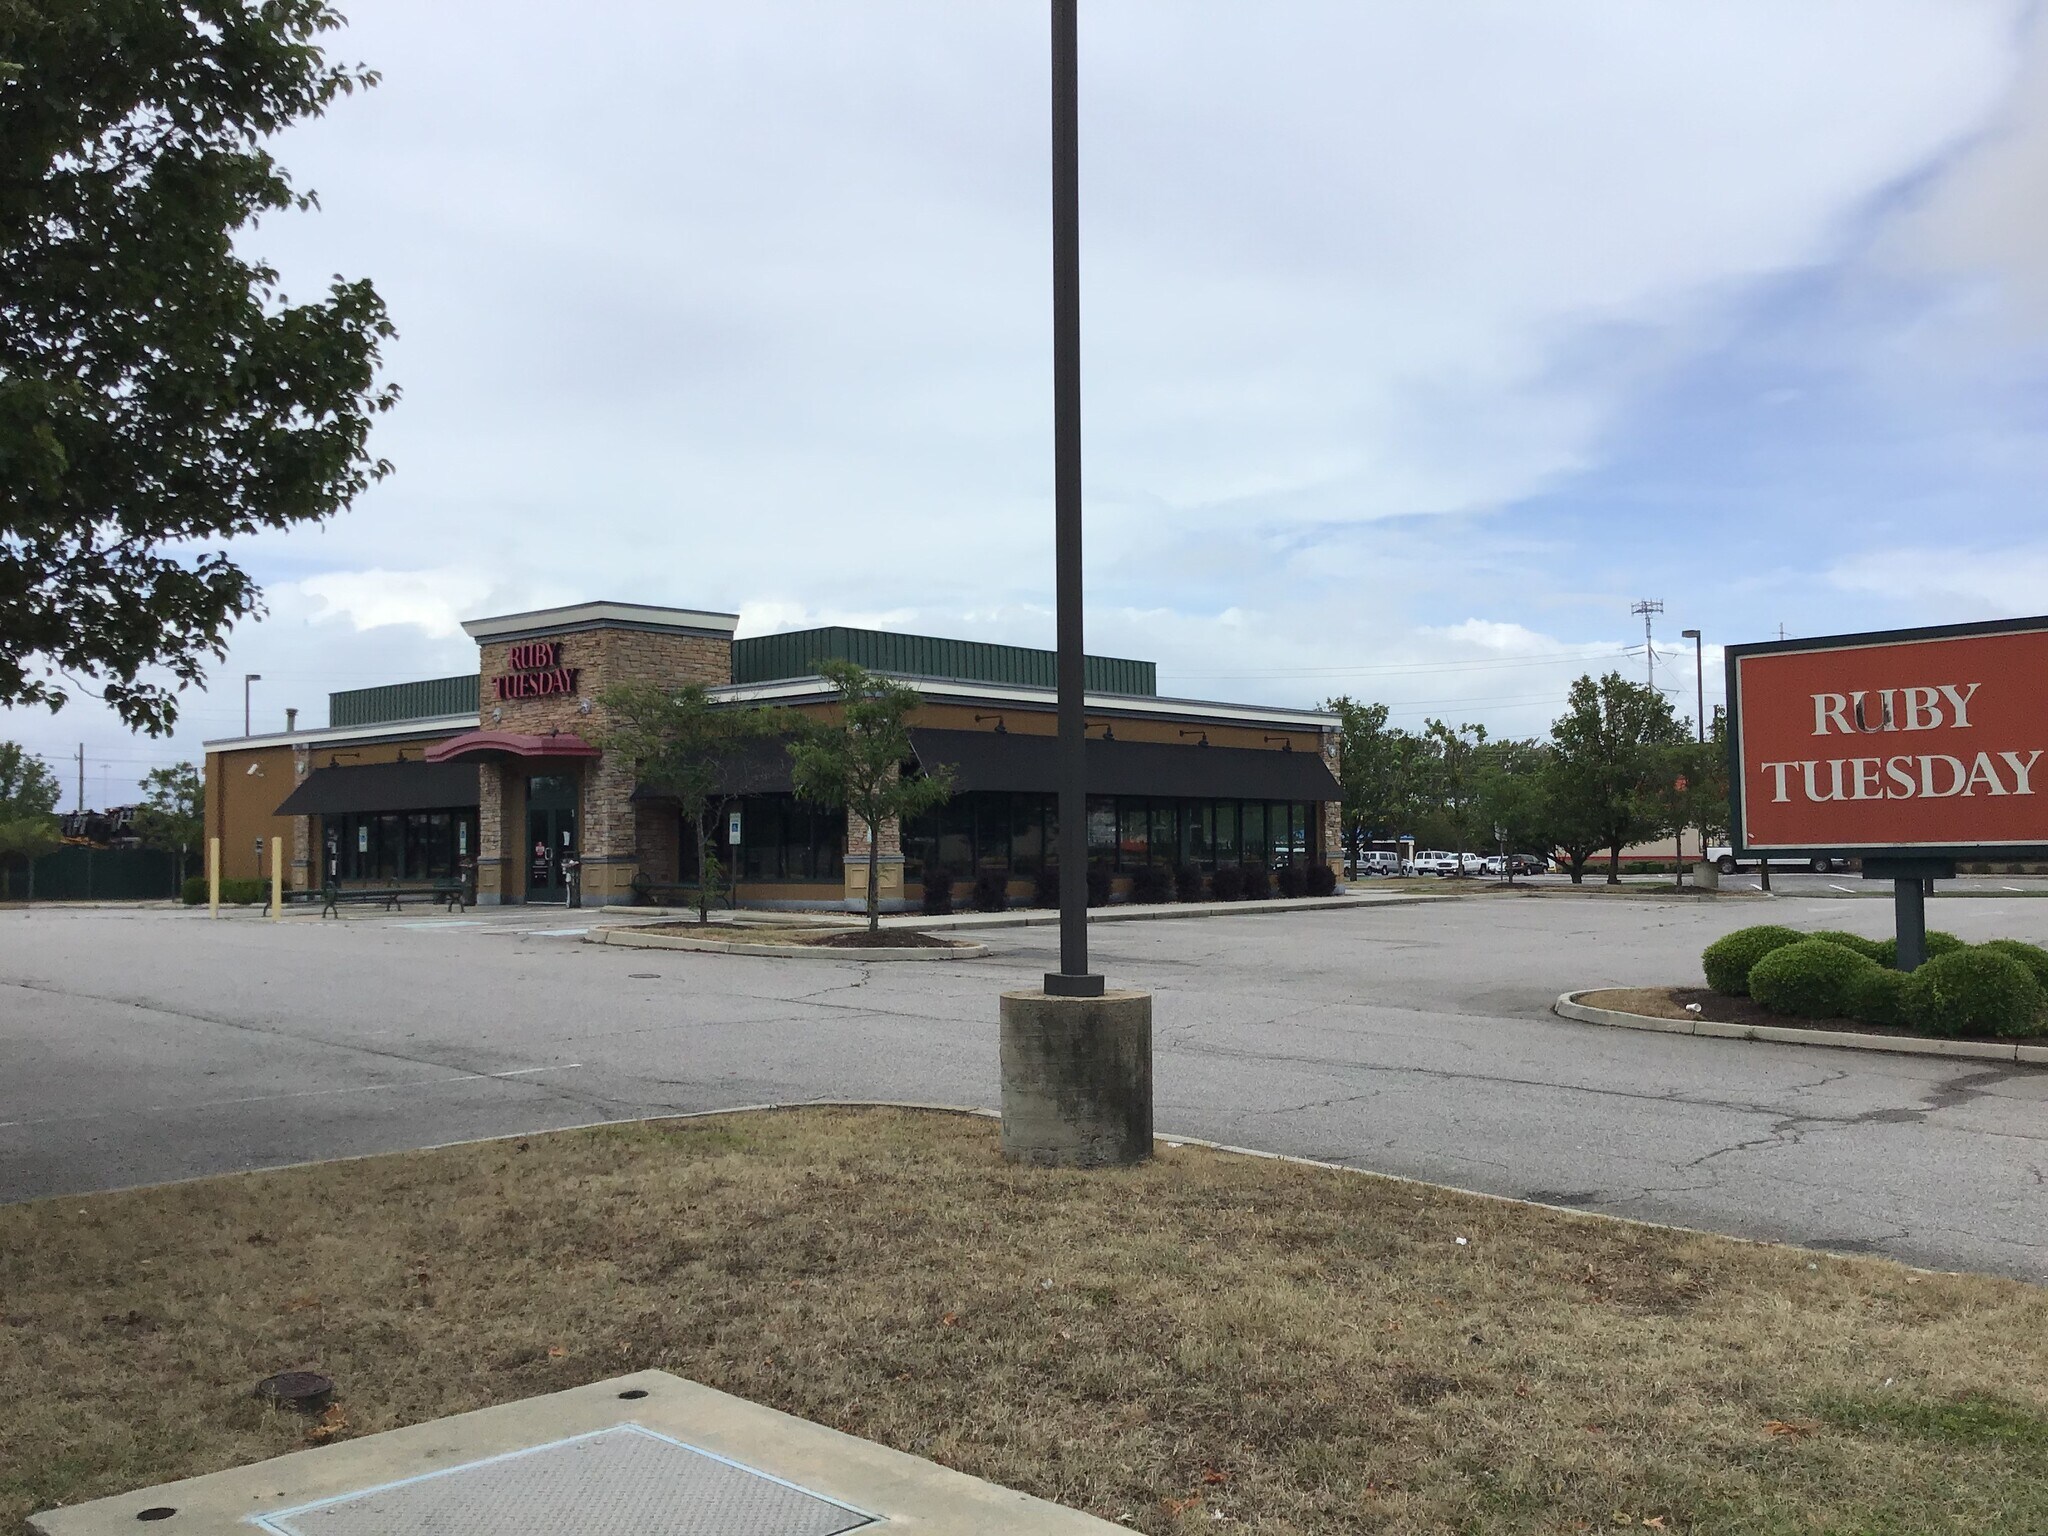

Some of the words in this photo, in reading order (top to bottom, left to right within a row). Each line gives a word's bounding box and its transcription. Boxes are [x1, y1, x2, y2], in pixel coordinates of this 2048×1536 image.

[508, 642, 558, 670] RUBY
[491, 668, 575, 699] TUESDAY
[1810, 682, 1982, 736] RUBY
[1760, 750, 2045, 803] TUESDAY
